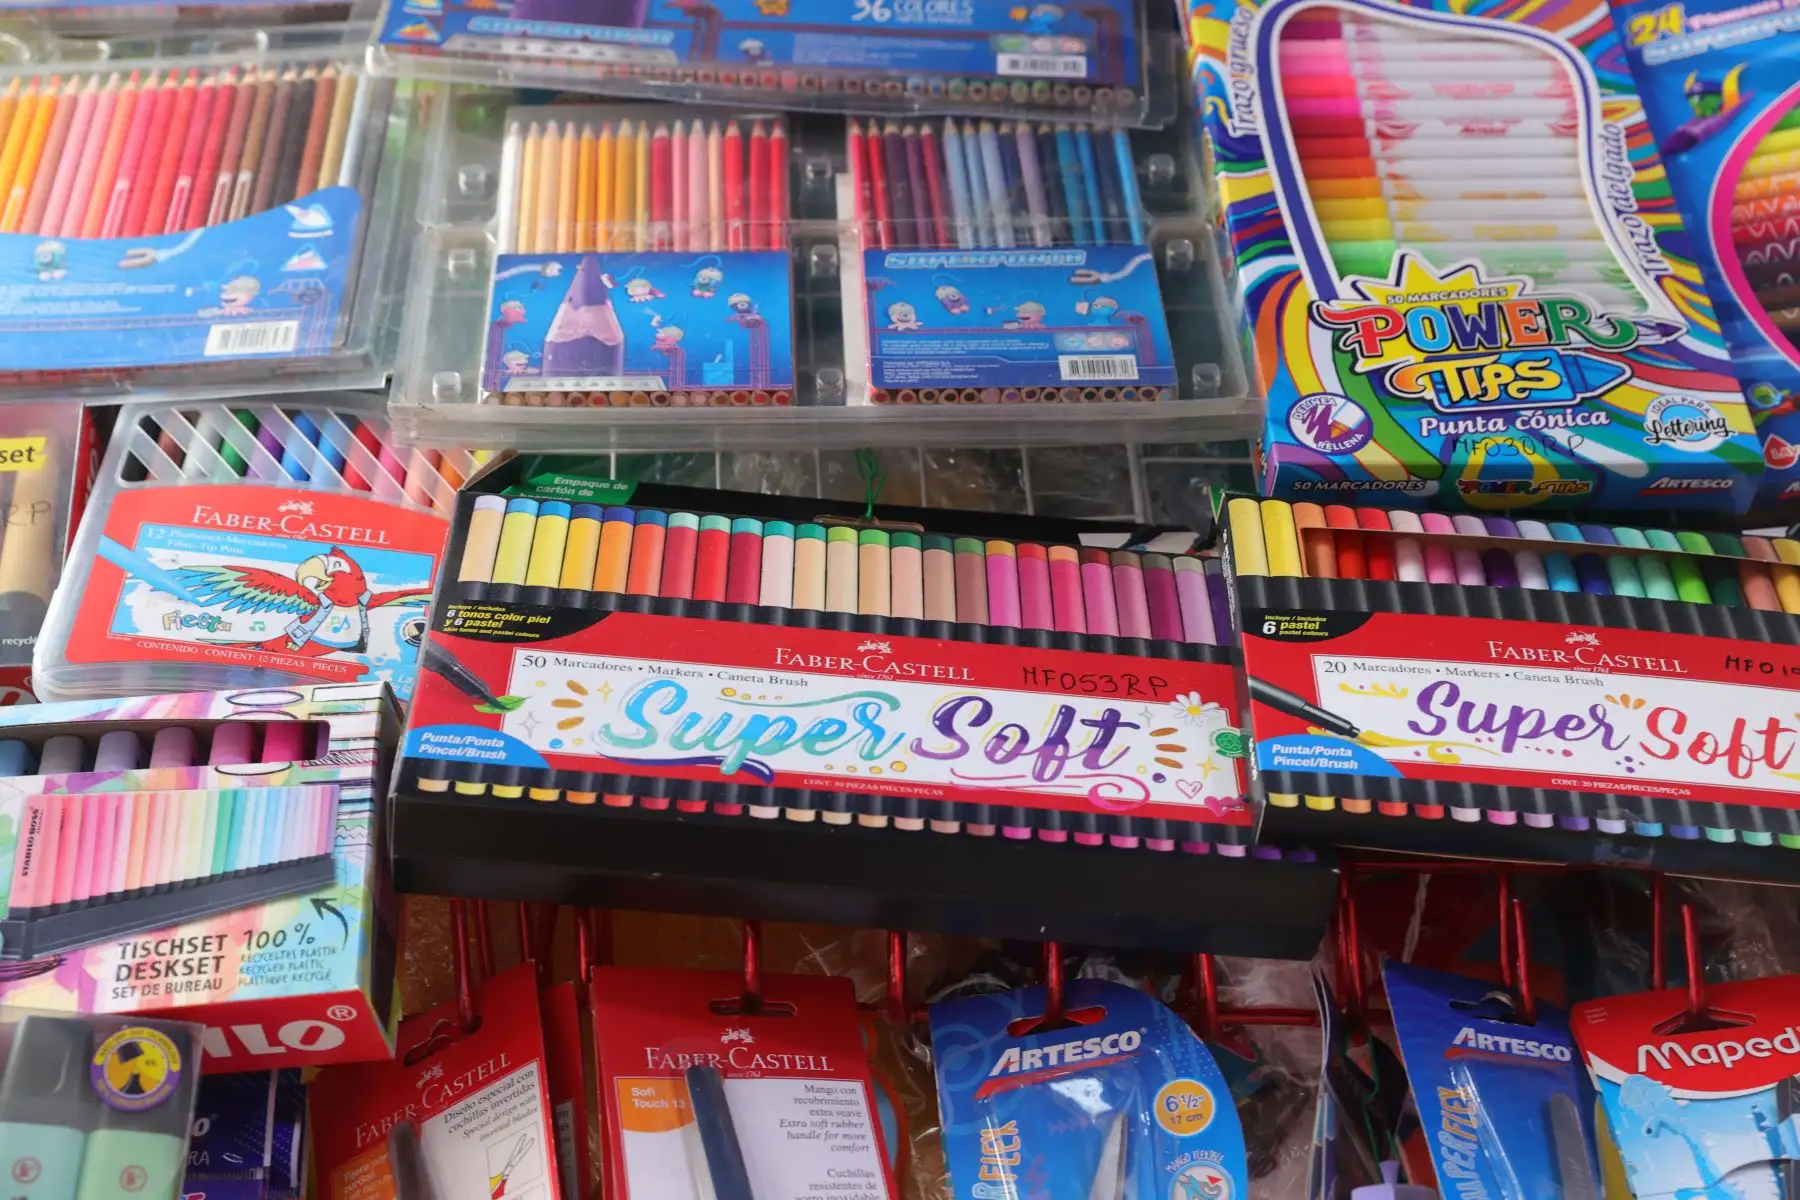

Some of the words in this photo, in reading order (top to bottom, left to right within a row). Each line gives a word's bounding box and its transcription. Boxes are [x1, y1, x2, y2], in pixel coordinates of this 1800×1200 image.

[1629, 5, 1681, 47] 24
[1231, 7, 1255, 75] grueso
[1231, 80, 1258, 133] Trazo
[1598, 122, 1634, 213] delgado
[1621, 213, 1671, 277] Trazo
[1386, 292, 1404, 303] 50
[1406, 287, 1508, 301] MARCADORES
[1315, 299, 1637, 358] POWER
[1394, 354, 1563, 402] TIPS
[1292, 395, 1338, 420] DELINEA
[1420, 416, 1508, 437] Punta
[1514, 408, 1611, 431] cónica
[1644, 416, 1737, 445] Lettering
[1316, 433, 1364, 451] RELLENA
[536, 484, 576, 496] cartón
[578, 488, 595, 497] de
[553, 476, 611, 489] Empaque
[612, 482, 629, 491] de
[1292, 481, 1312, 491] 50
[1314, 479, 1427, 491] MARCADORES
[1650, 476, 1734, 490] ARTESCO
[147, 527, 165, 539] 12
[191, 504, 391, 545] FABER-CASTELL
[162, 609, 233, 633] Fiesta
[443, 619, 453, 628] y
[454, 618, 464, 627] 6
[464, 619, 504, 629] pastel
[446, 609, 457, 618] 6
[458, 609, 492, 619] tonos
[494, 613, 527, 622] color
[526, 616, 552, 625] piel
[1262, 621, 1277, 635] 6
[1280, 621, 1320, 631] pastel
[136, 640, 199, 655] CONTENIDO
[311, 661, 348, 674] PIECES
[774, 647, 975, 681] FABER-CASTELL
[1486, 640, 1689, 674] FABER-CASTELL
[521, 654, 547, 669] 50
[553, 656, 634, 673] Marcadores
[647, 663, 704, 679] Markers
[717, 670, 764, 684] Caneta
[768, 674, 809, 688] Brush
[1323, 660, 1347, 674] 20
[1352, 661, 1432, 676] Marcadores
[1445, 666, 1501, 680] Markers
[1513, 671, 1561, 685] Caneta
[1564, 675, 1605, 688] Brush
[421, 732, 505, 748] Punta/Ponta
[598, 678, 905, 776] Super
[910, 694, 1141, 783] Soft
[1407, 679, 1632, 755] Super
[1638, 705, 1799, 781] Soft
[418, 743, 508, 761] Pincel/Brush
[1271, 743, 1353, 757] Punta/Ponta
[1273, 755, 1359, 770] Pincel/Brush
[118, 934, 229, 960] TISCHSET
[243, 929, 288, 951] 100
[294, 922, 316, 946] %
[115, 955, 225, 982] DESKSET
[112, 986, 138, 1000] SET
[141, 984, 160, 997] DE
[164, 978, 223, 995] BUREAU
[988, 1030, 1142, 1076] ARTESCO
[1453, 1026, 1572, 1063] ARTESCO
[1636, 1026, 1800, 1074] Maped
[644, 1046, 835, 1072] FABER-CASTELL
[631, 1087, 656, 1097] Soft
[793, 1096, 860, 1107] recubrimiento
[804, 1085, 838, 1096] Mango
[839, 1087, 857, 1095] con
[632, 1099, 669, 1109] Touch
[808, 1108, 834, 1117] extra
[835, 1109, 863, 1118] suave
[1165, 1095, 1180, 1112] 6
[779, 1118, 808, 1129] Extra
[809, 1118, 829, 1130] soft
[830, 1119, 865, 1130] rubber
[1169, 1115, 1182, 1125] 17
[1186, 1113, 1204, 1122] cm
[786, 1129, 822, 1141] handle
[822, 1130, 839, 1142] for
[841, 1133, 867, 1142] more
[830, 1142, 870, 1154] comfort
[826, 1167, 876, 1179] Cuchillas
[808, 1181, 863, 1192] resistentes
[864, 1180, 878, 1191] de
